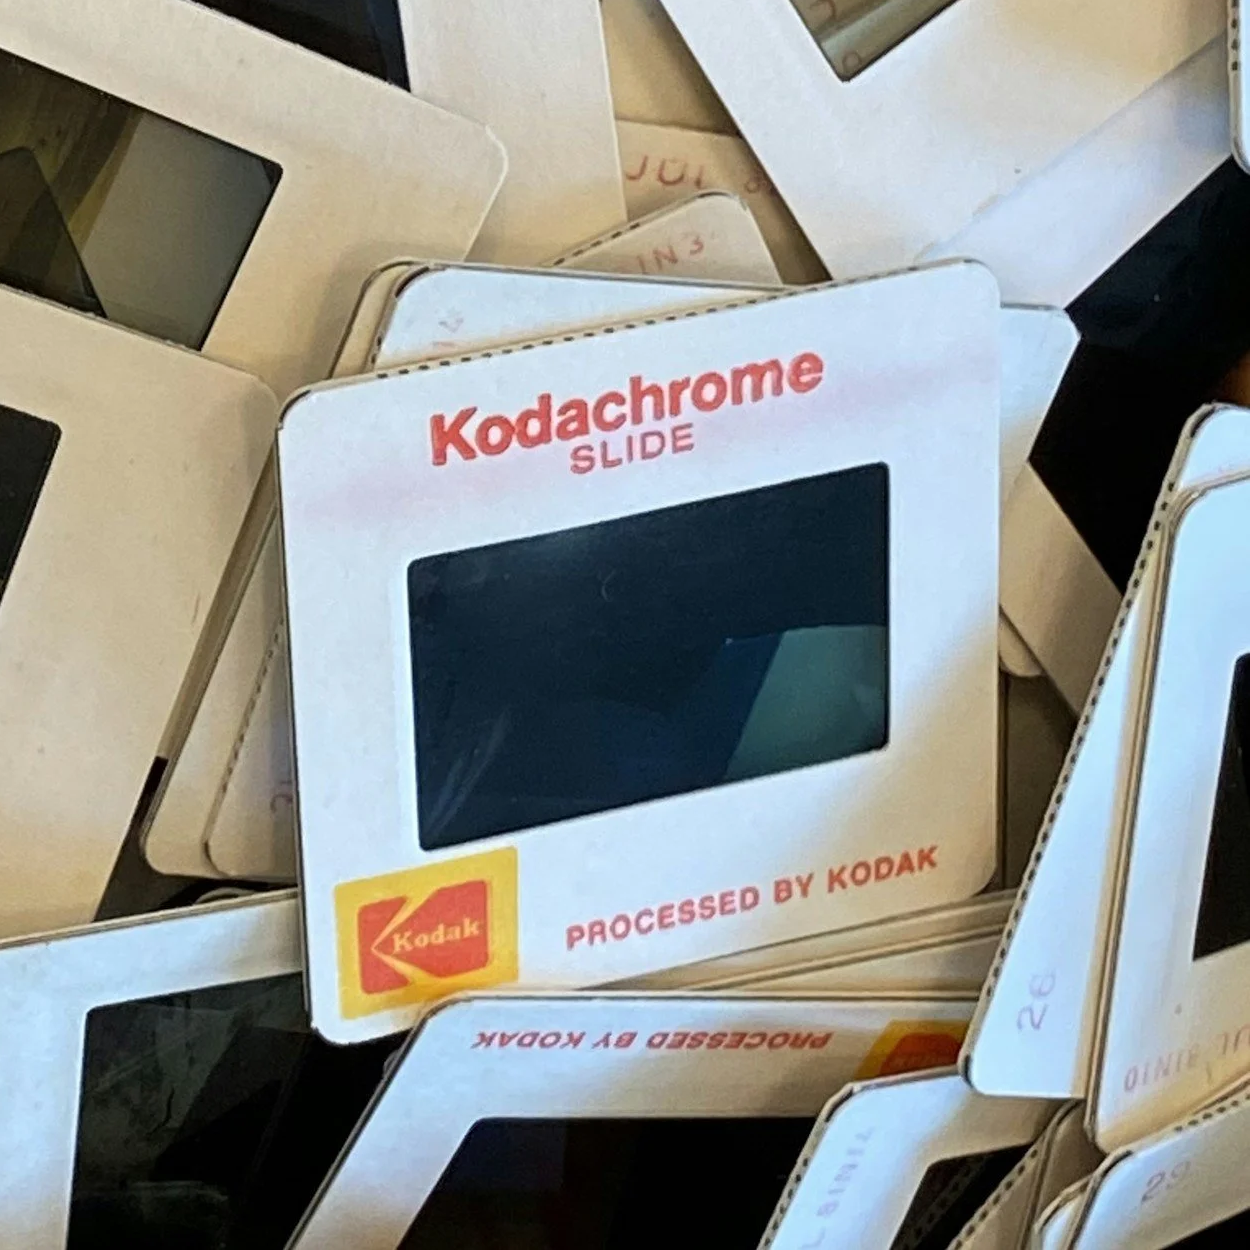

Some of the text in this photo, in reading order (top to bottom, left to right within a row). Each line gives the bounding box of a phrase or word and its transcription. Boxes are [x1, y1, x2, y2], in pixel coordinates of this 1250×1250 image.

[429, 351, 826, 467] Kodachrome
[569, 422, 696, 475] SLIDE
[566, 845, 940, 952] PROCESSED BY KODAK
[392, 916, 480, 954] Kodak
[471, 1030, 834, 1051] PROCESSED BY KODAK
